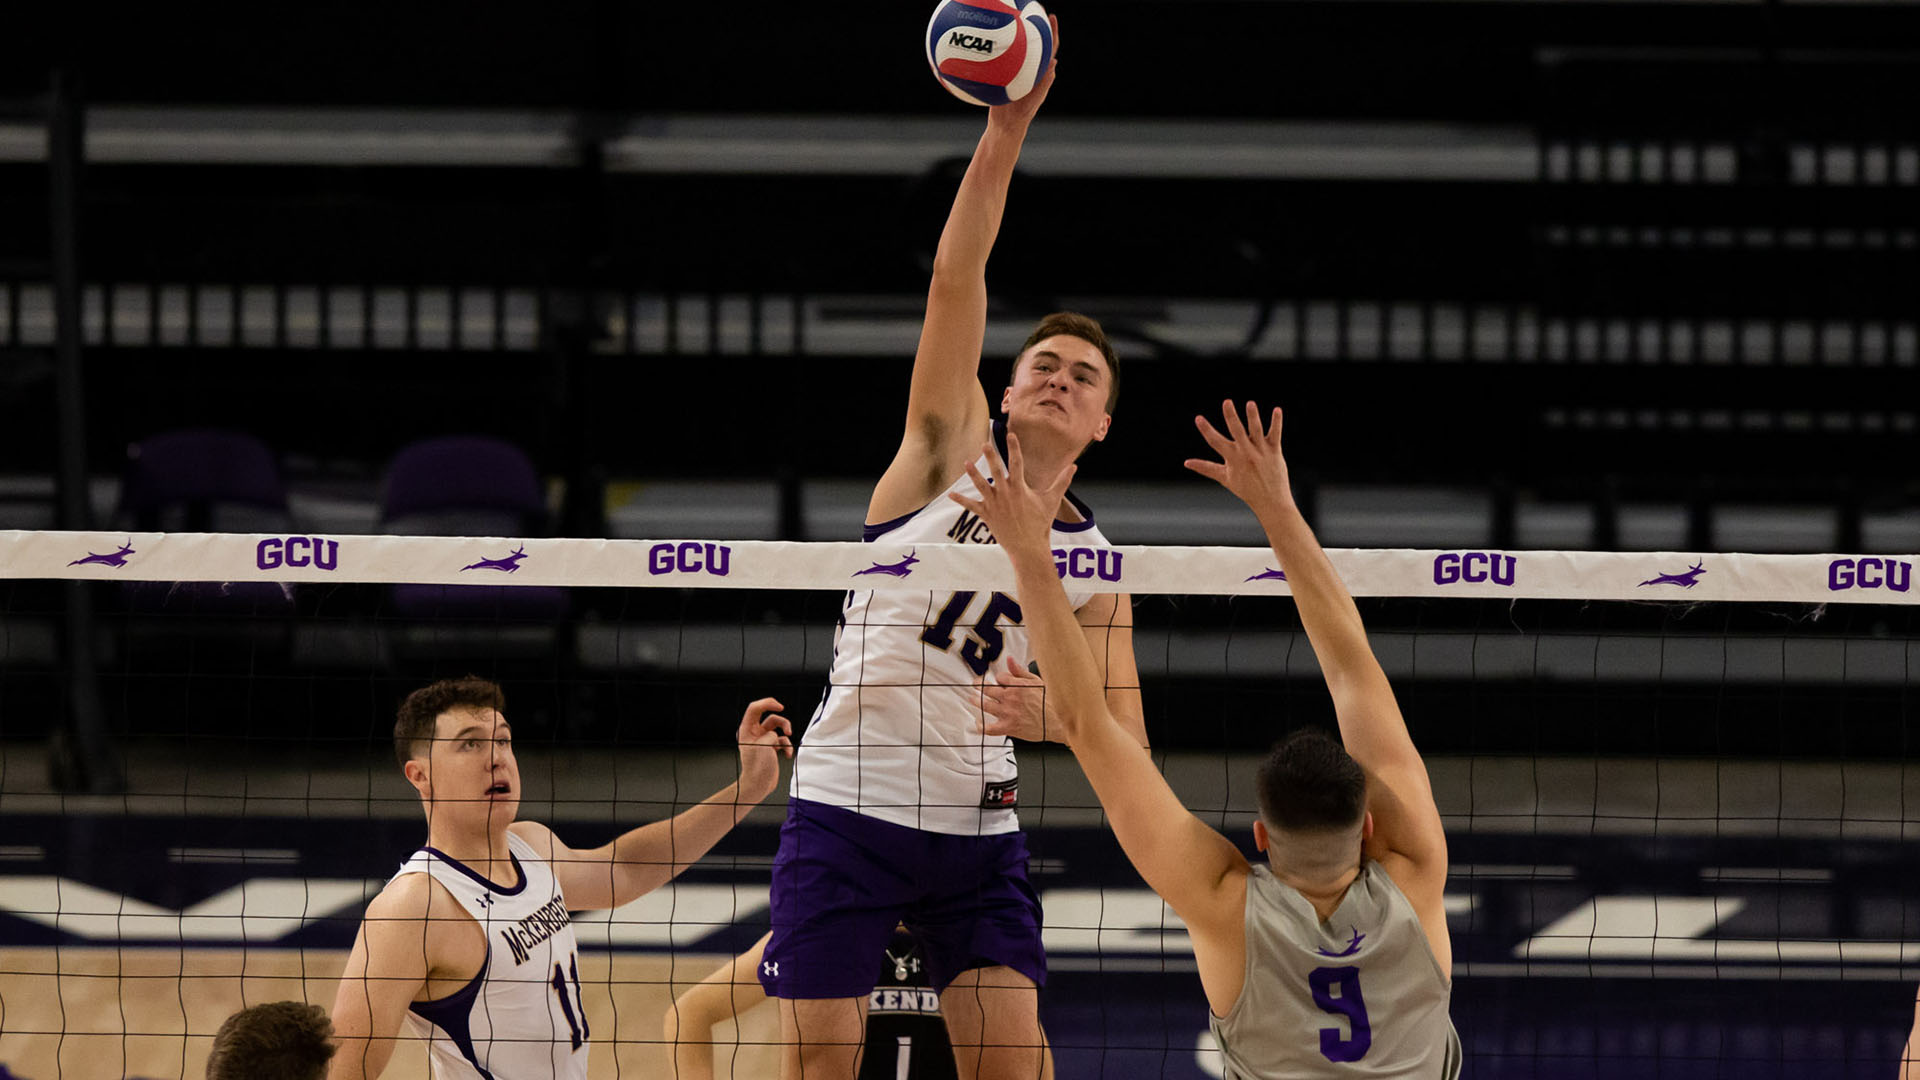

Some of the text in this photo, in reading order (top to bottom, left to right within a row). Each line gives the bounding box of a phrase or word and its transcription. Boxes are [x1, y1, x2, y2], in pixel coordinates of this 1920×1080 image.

[957, 10, 998, 25] molten
[949, 31, 994, 53] NCAA
[257, 536, 339, 571] GCU
[648, 542, 731, 576] GCU
[1051, 548, 1123, 582] GCU
[1433, 552, 1517, 586] GCU
[1828, 558, 1912, 592] GCU
[918, 591, 1023, 676] 15
[551, 951, 590, 1054] 11
[1308, 965, 1372, 1063] 9
